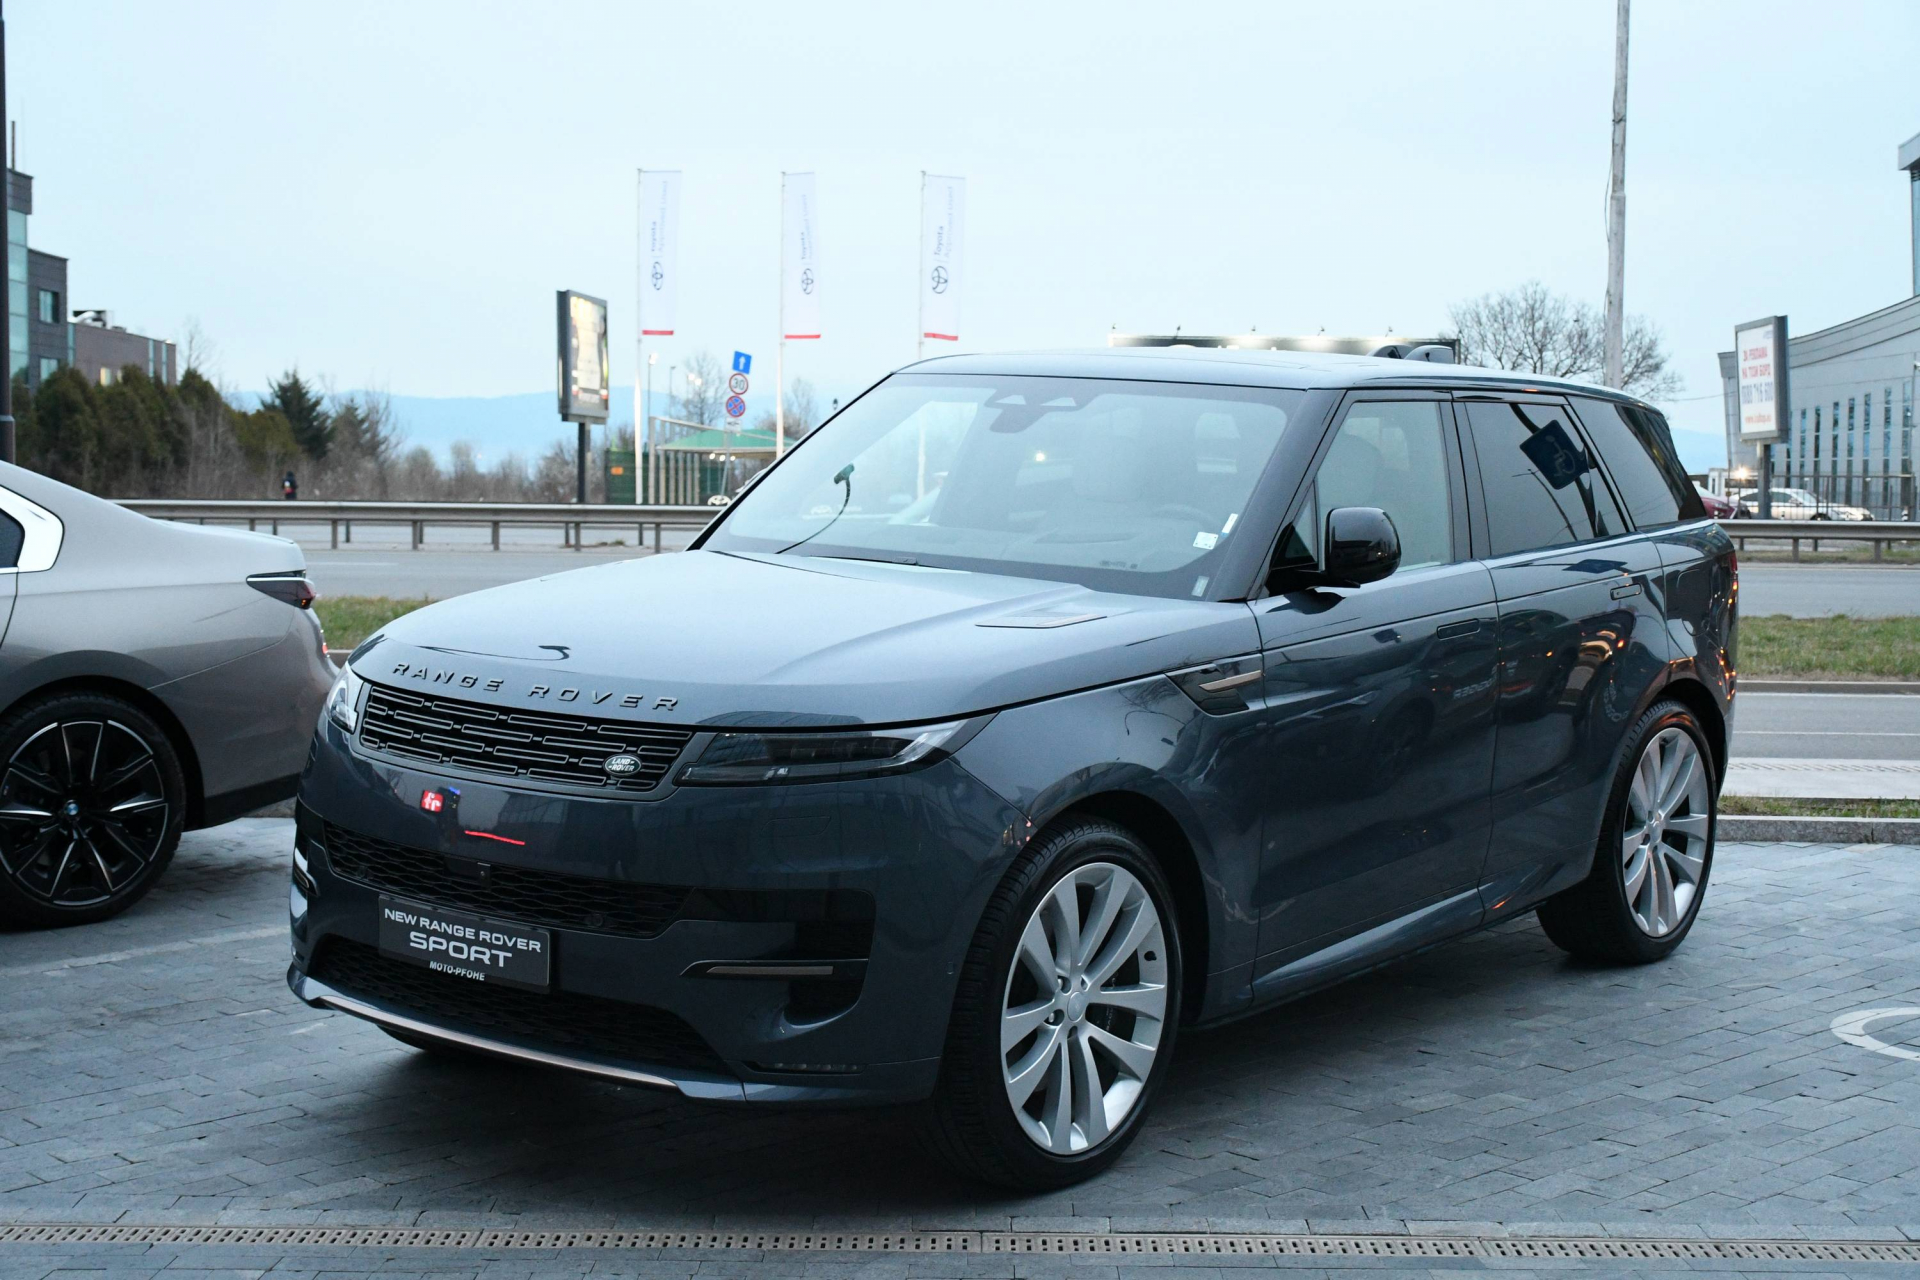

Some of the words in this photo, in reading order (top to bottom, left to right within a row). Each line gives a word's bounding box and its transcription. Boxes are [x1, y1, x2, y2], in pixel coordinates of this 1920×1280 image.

[934, 225, 944, 256] Toyota
[733, 378, 745, 391] 30
[392, 663, 504, 691] RANGE
[527, 684, 679, 711] ROVER
[384, 908, 417, 926] NEW
[419, 917, 476, 939] RANGE
[479, 930, 541, 952] ROVER
[409, 931, 513, 967] SPORT
[429, 960, 486, 981] MOTO-PFOHE
